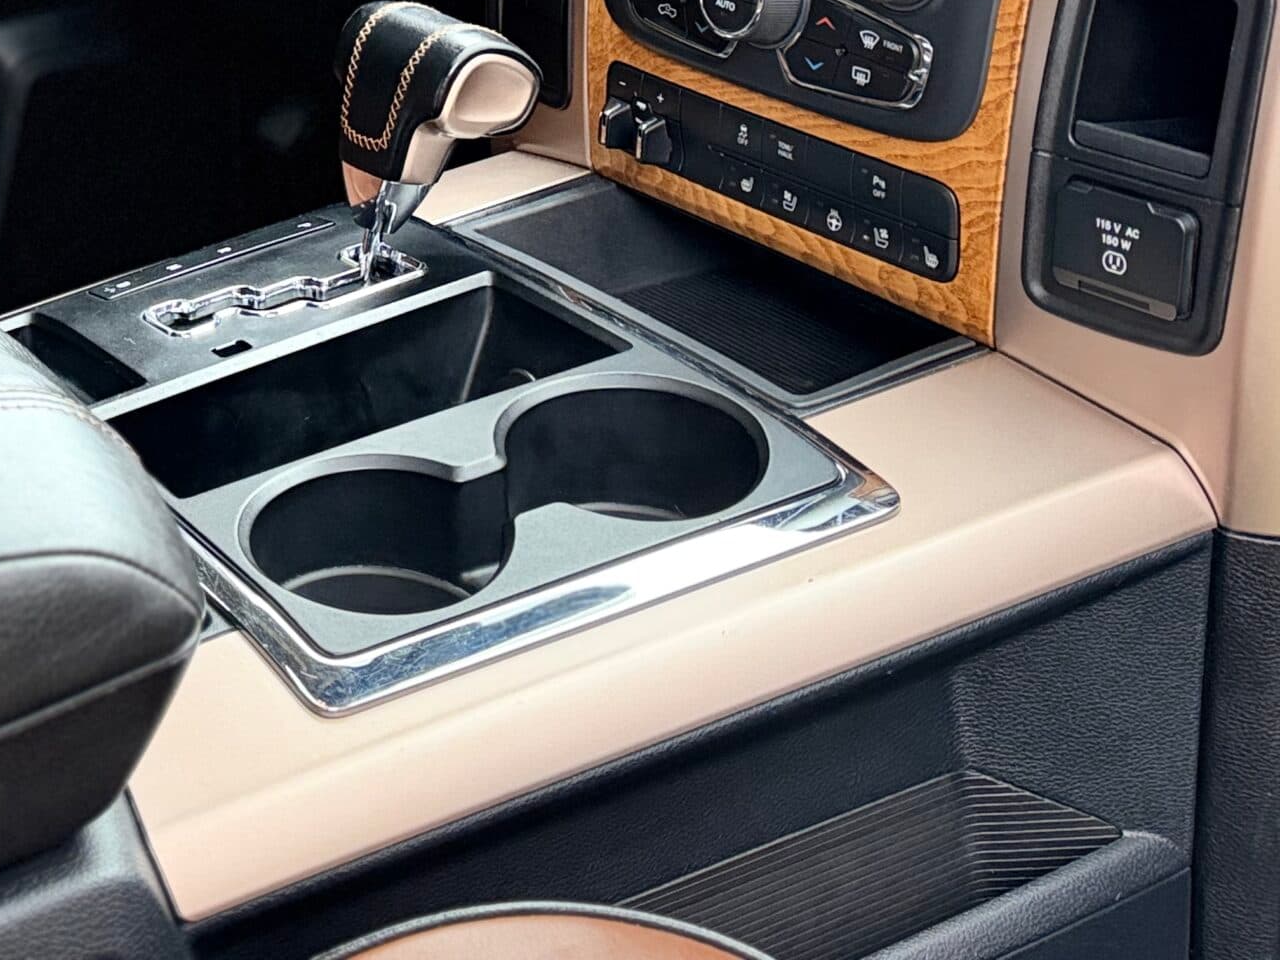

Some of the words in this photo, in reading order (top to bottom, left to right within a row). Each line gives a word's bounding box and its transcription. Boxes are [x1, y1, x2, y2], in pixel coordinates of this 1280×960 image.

[882, 40, 903, 53] FRONT
[1113, 222, 1122, 234] V
[1125, 226, 1140, 240] AC
[1120, 238, 1132, 252] W
